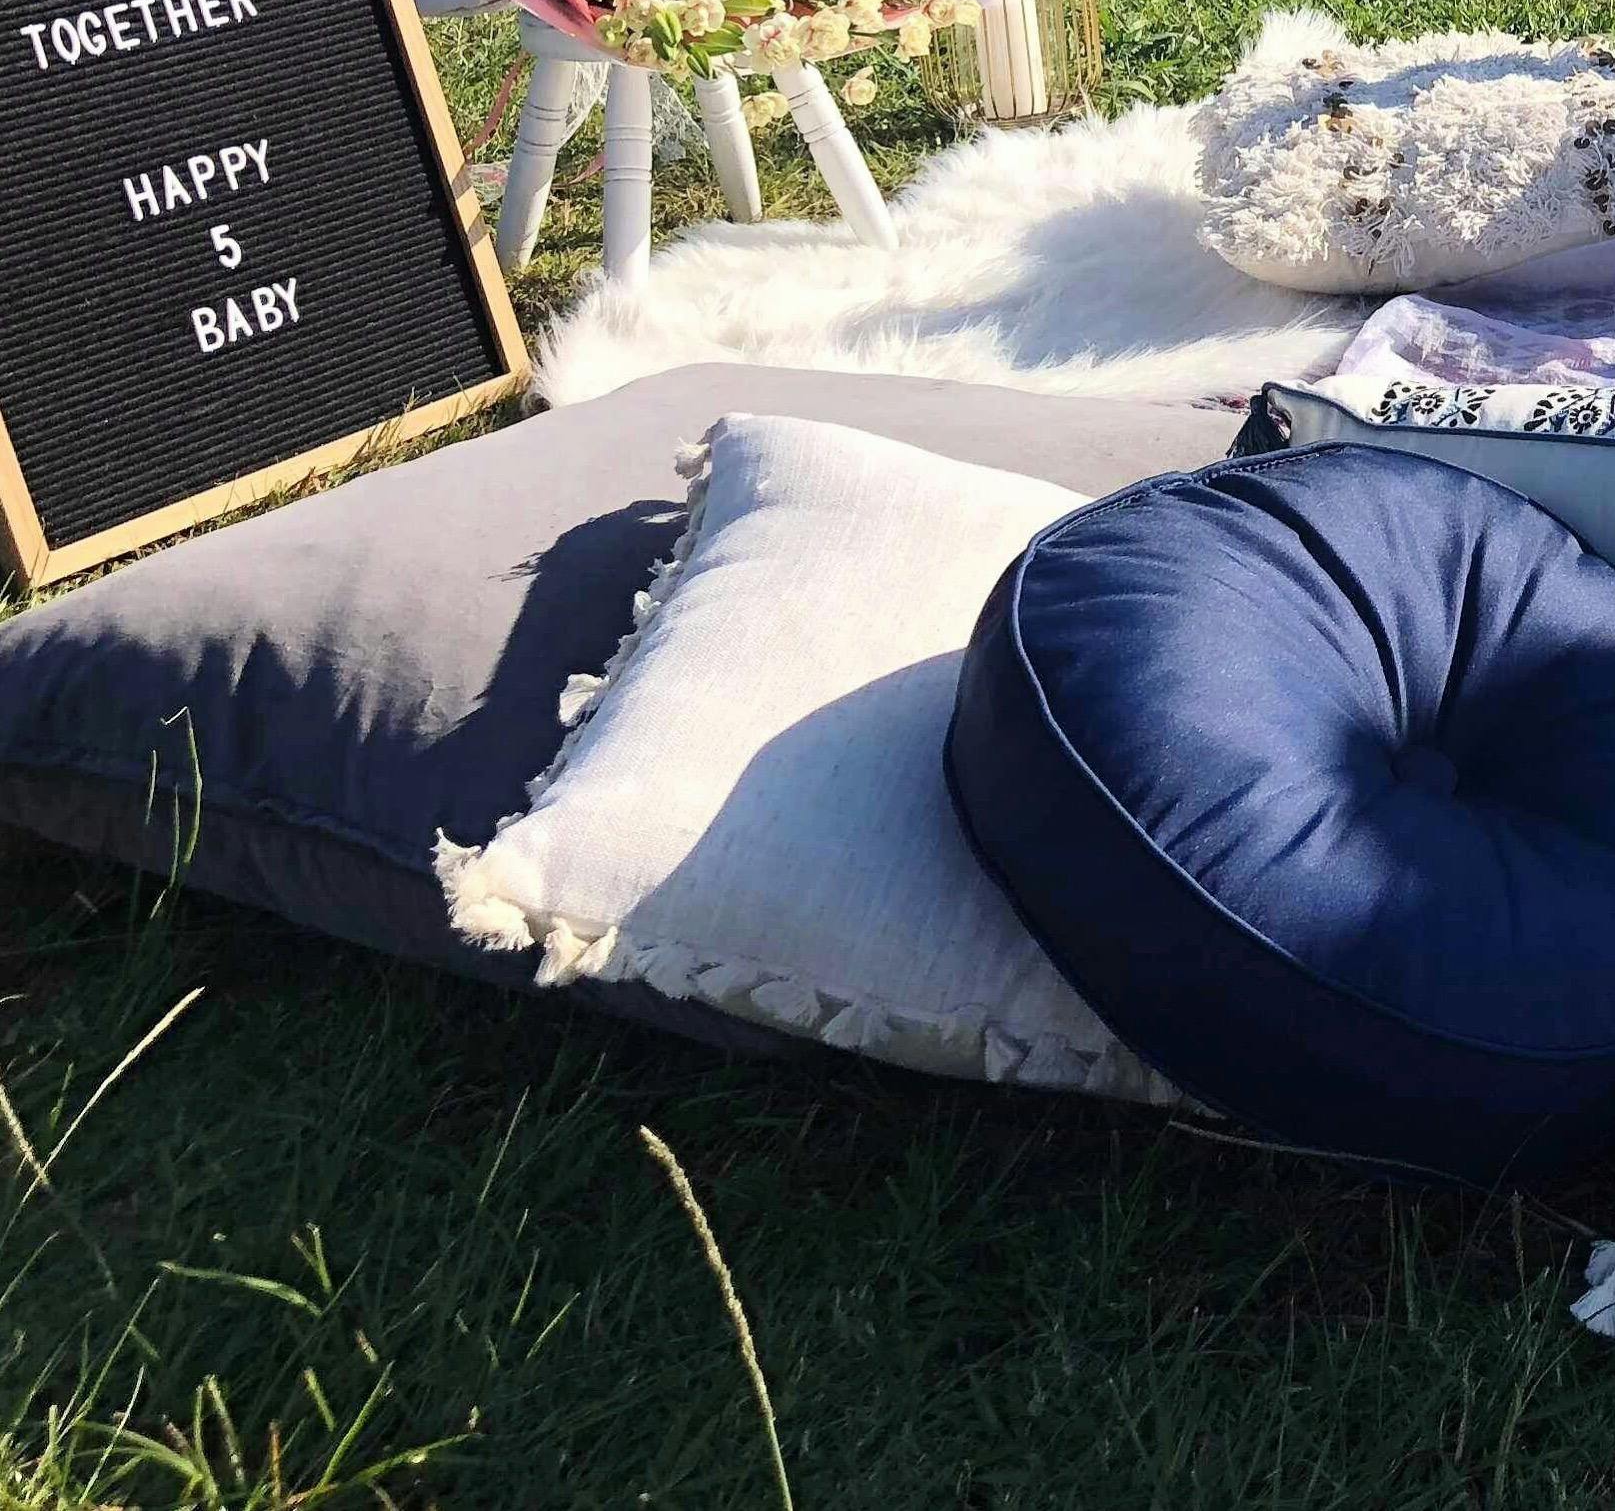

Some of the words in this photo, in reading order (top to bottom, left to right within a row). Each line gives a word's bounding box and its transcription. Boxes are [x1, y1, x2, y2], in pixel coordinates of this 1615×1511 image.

[123, 138, 271, 222] HAPPY
[210, 224, 242, 270] 5
[190, 277, 301, 353] BABY
